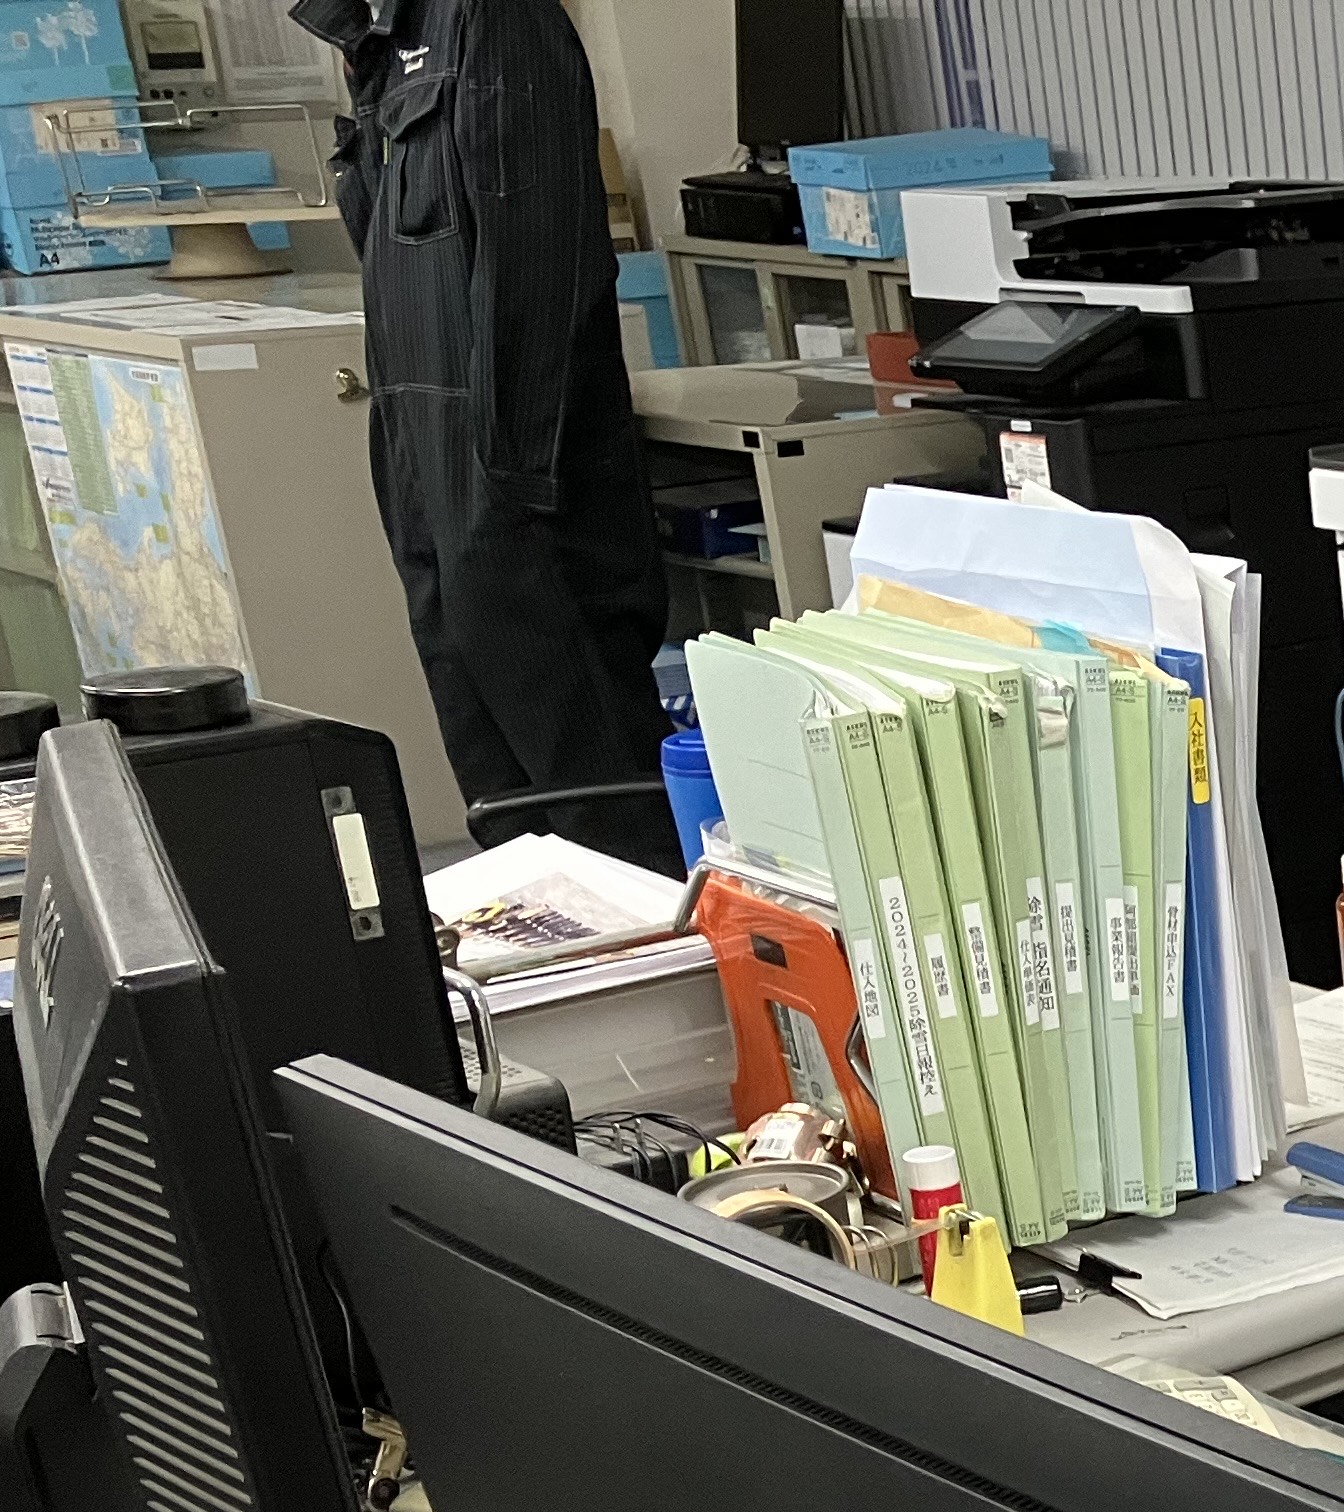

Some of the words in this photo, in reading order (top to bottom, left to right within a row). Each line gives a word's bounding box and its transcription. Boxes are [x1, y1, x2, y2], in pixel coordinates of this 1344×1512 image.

[1190, 712, 1208, 785] 入社書類
[860, 961, 880, 1019] 仕入地図
[1033, 941, 1055, 1013] 指名通知
